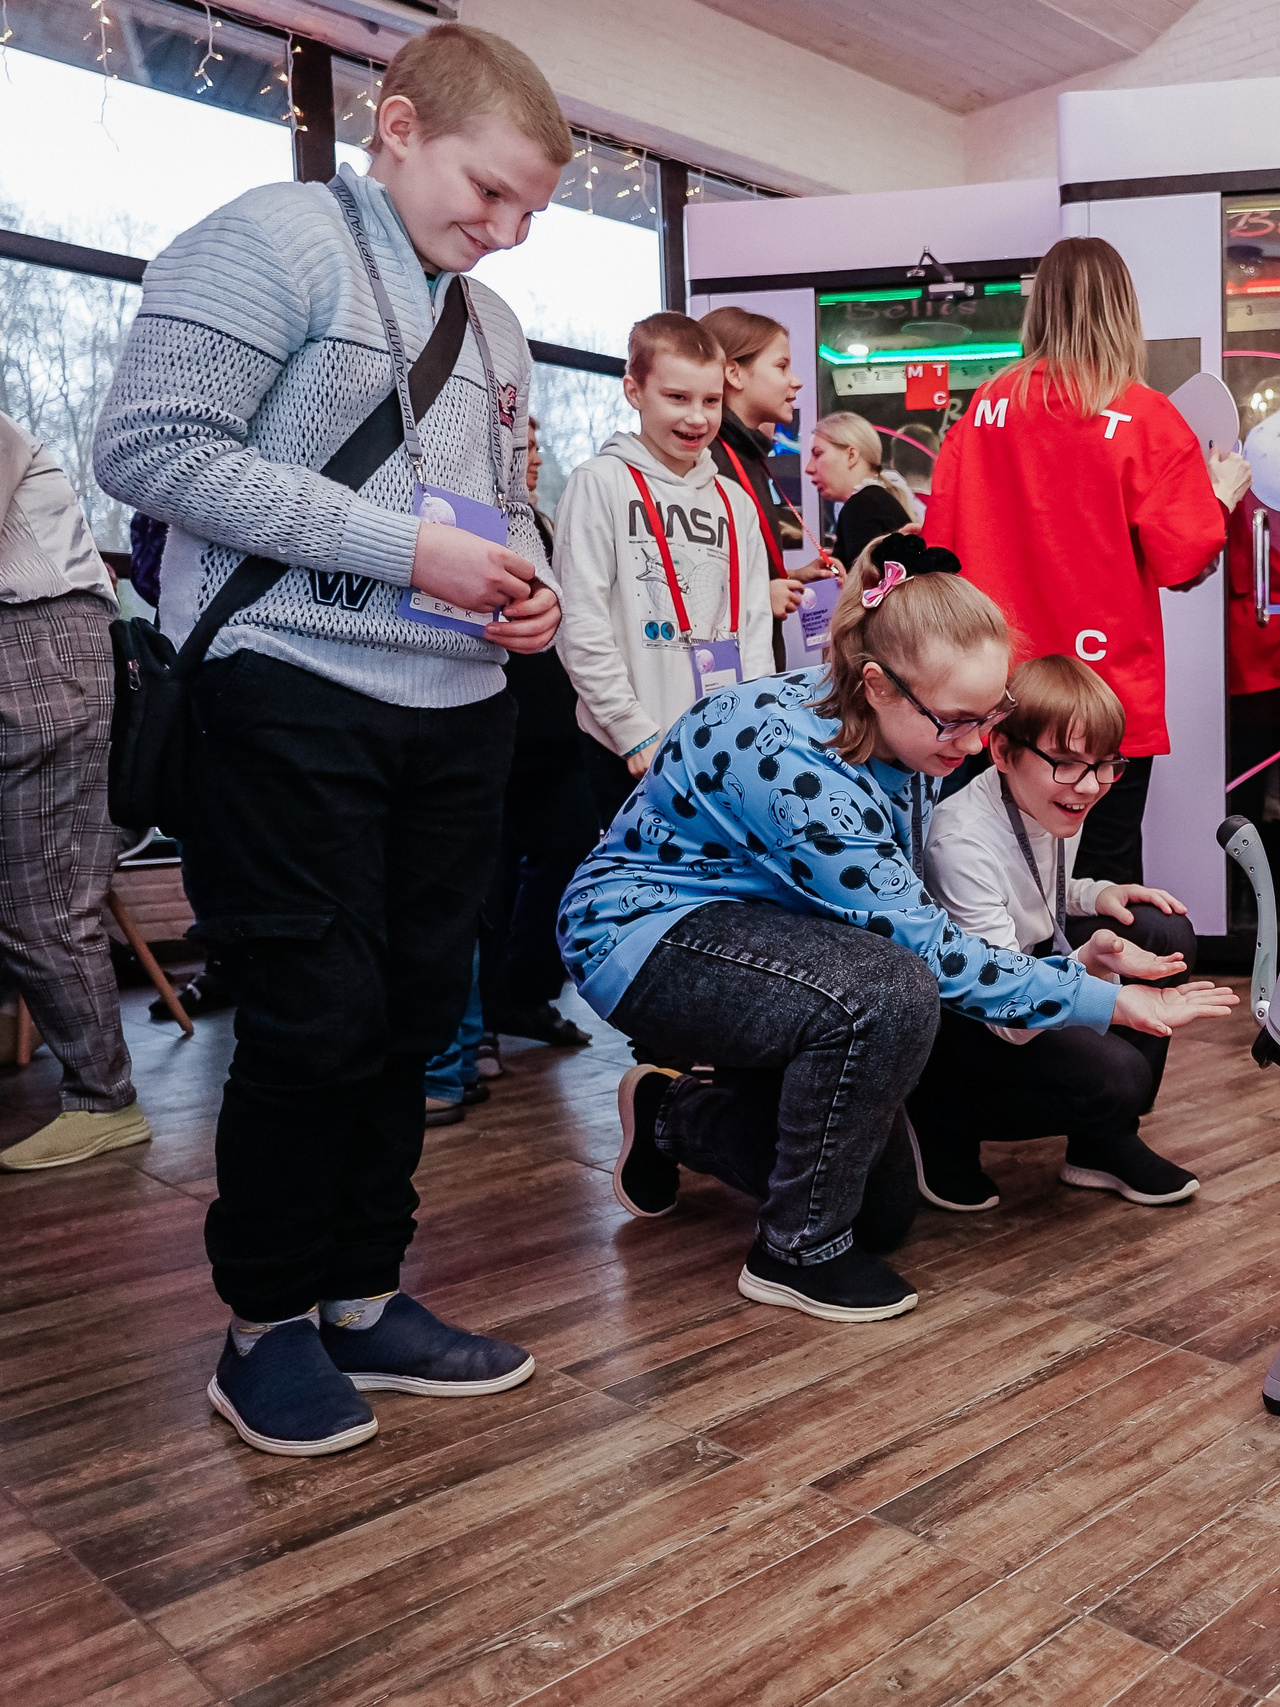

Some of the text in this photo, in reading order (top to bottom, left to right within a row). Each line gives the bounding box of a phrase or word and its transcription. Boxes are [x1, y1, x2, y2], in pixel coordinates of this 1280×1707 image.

[333, 184, 380, 281] ВИРТУАЛИТИ
[382, 318, 415, 431] ВИРТУАЛИТИ
[486, 369, 502, 468] ВИРТУАЛИТИ
